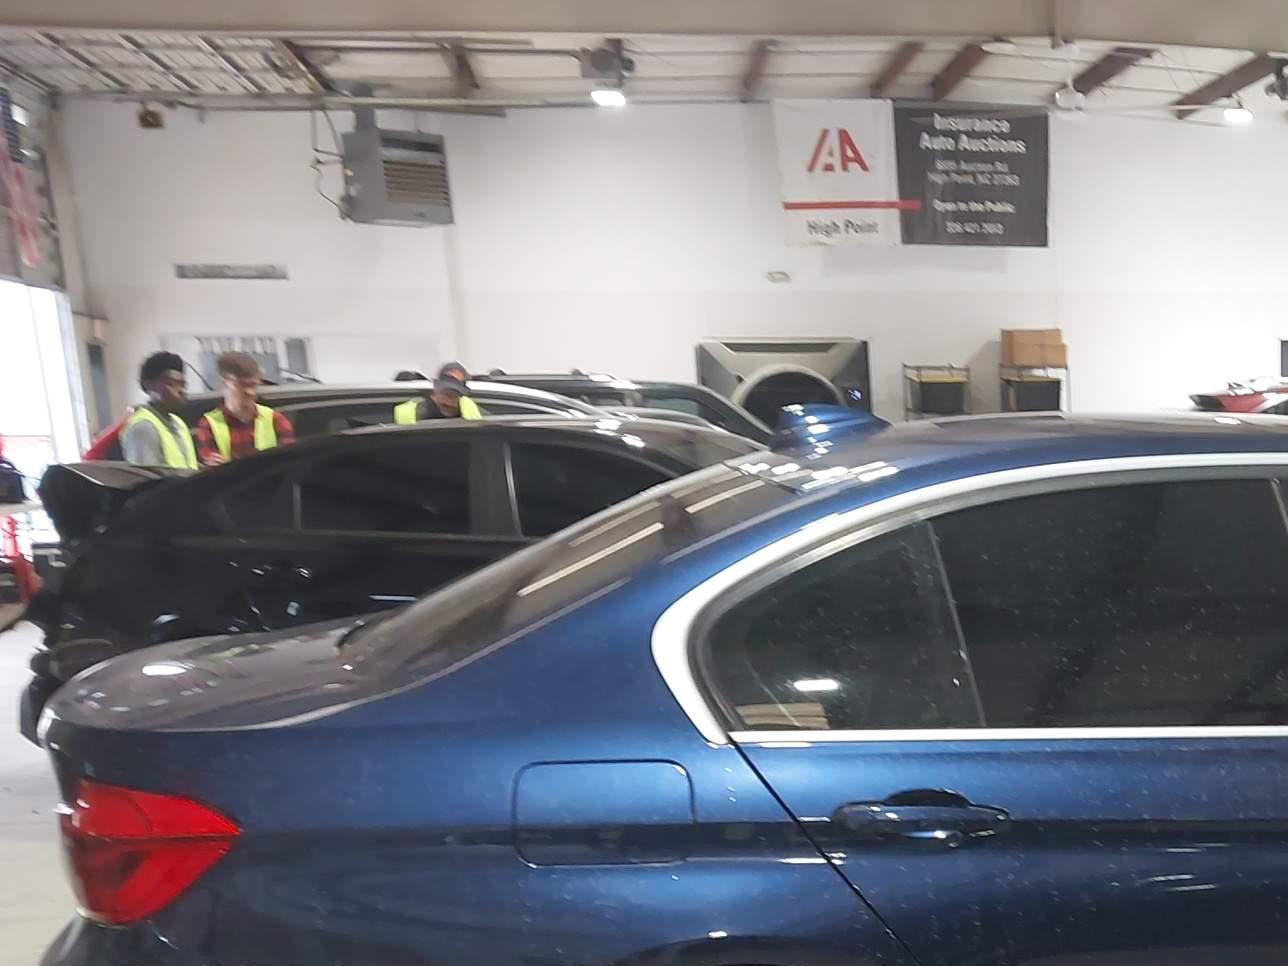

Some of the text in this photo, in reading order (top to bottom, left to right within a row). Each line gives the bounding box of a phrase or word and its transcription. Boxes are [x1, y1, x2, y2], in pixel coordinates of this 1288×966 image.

[933, 112, 1010, 133] Insurance
[920, 131, 1027, 153] Auto Auctions
[806, 218, 879, 238] High Point
